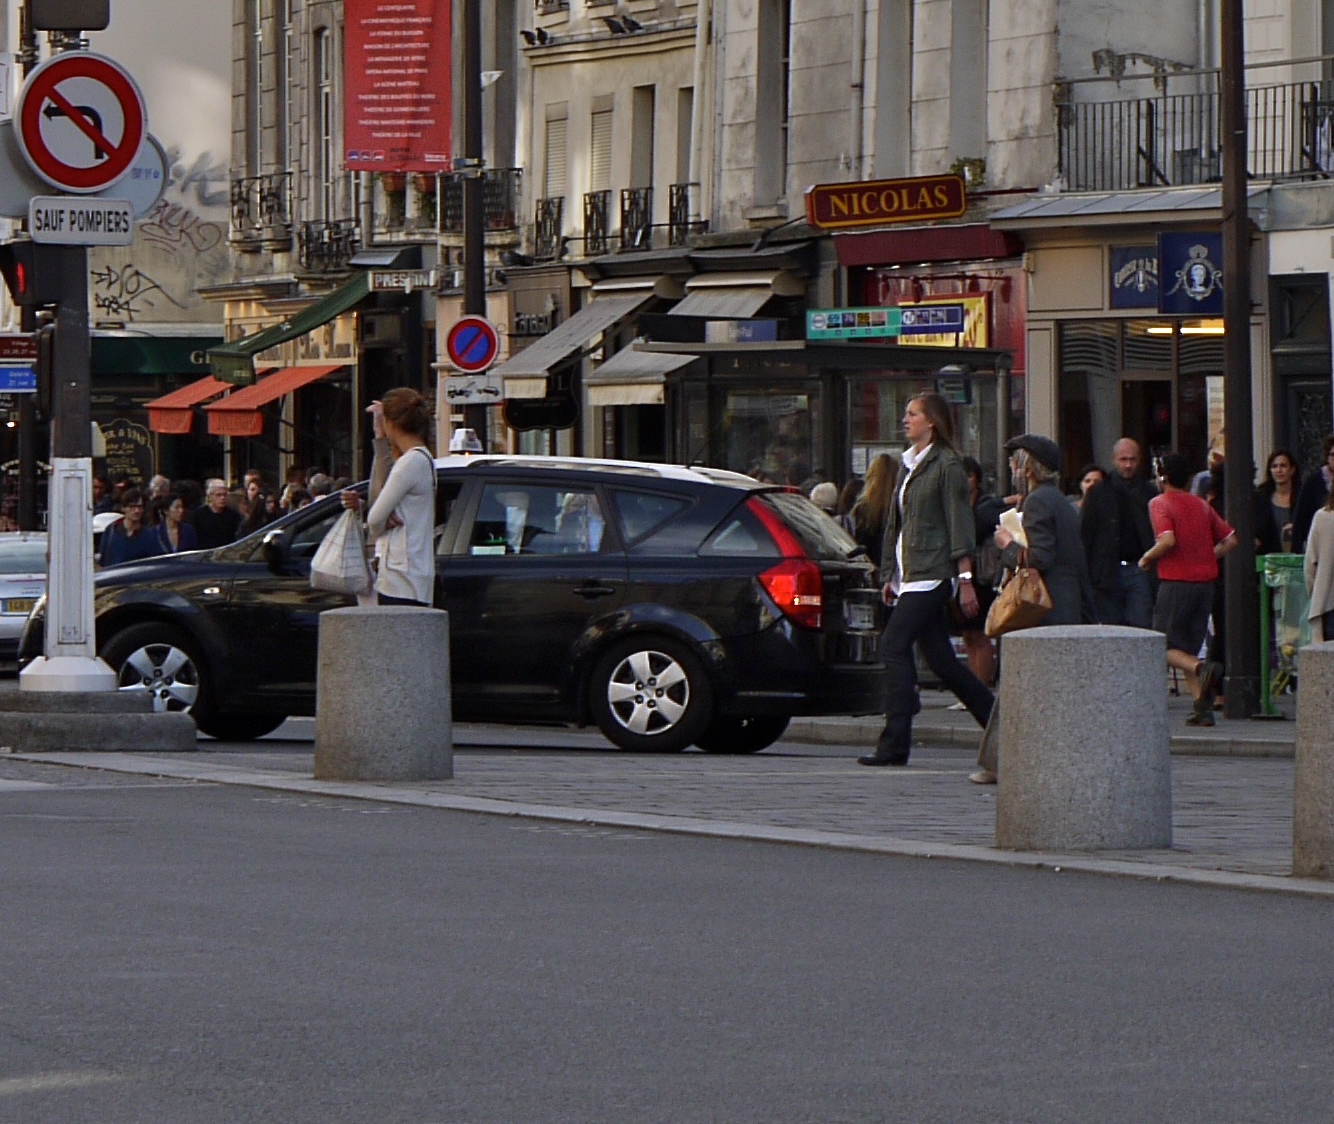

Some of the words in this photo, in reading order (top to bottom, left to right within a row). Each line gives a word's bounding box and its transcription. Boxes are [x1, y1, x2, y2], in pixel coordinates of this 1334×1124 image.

[829, 185, 949, 218] NICOLAS
[35, 209, 65, 231] SAUF
[69, 210, 129, 233] POMPIERS
